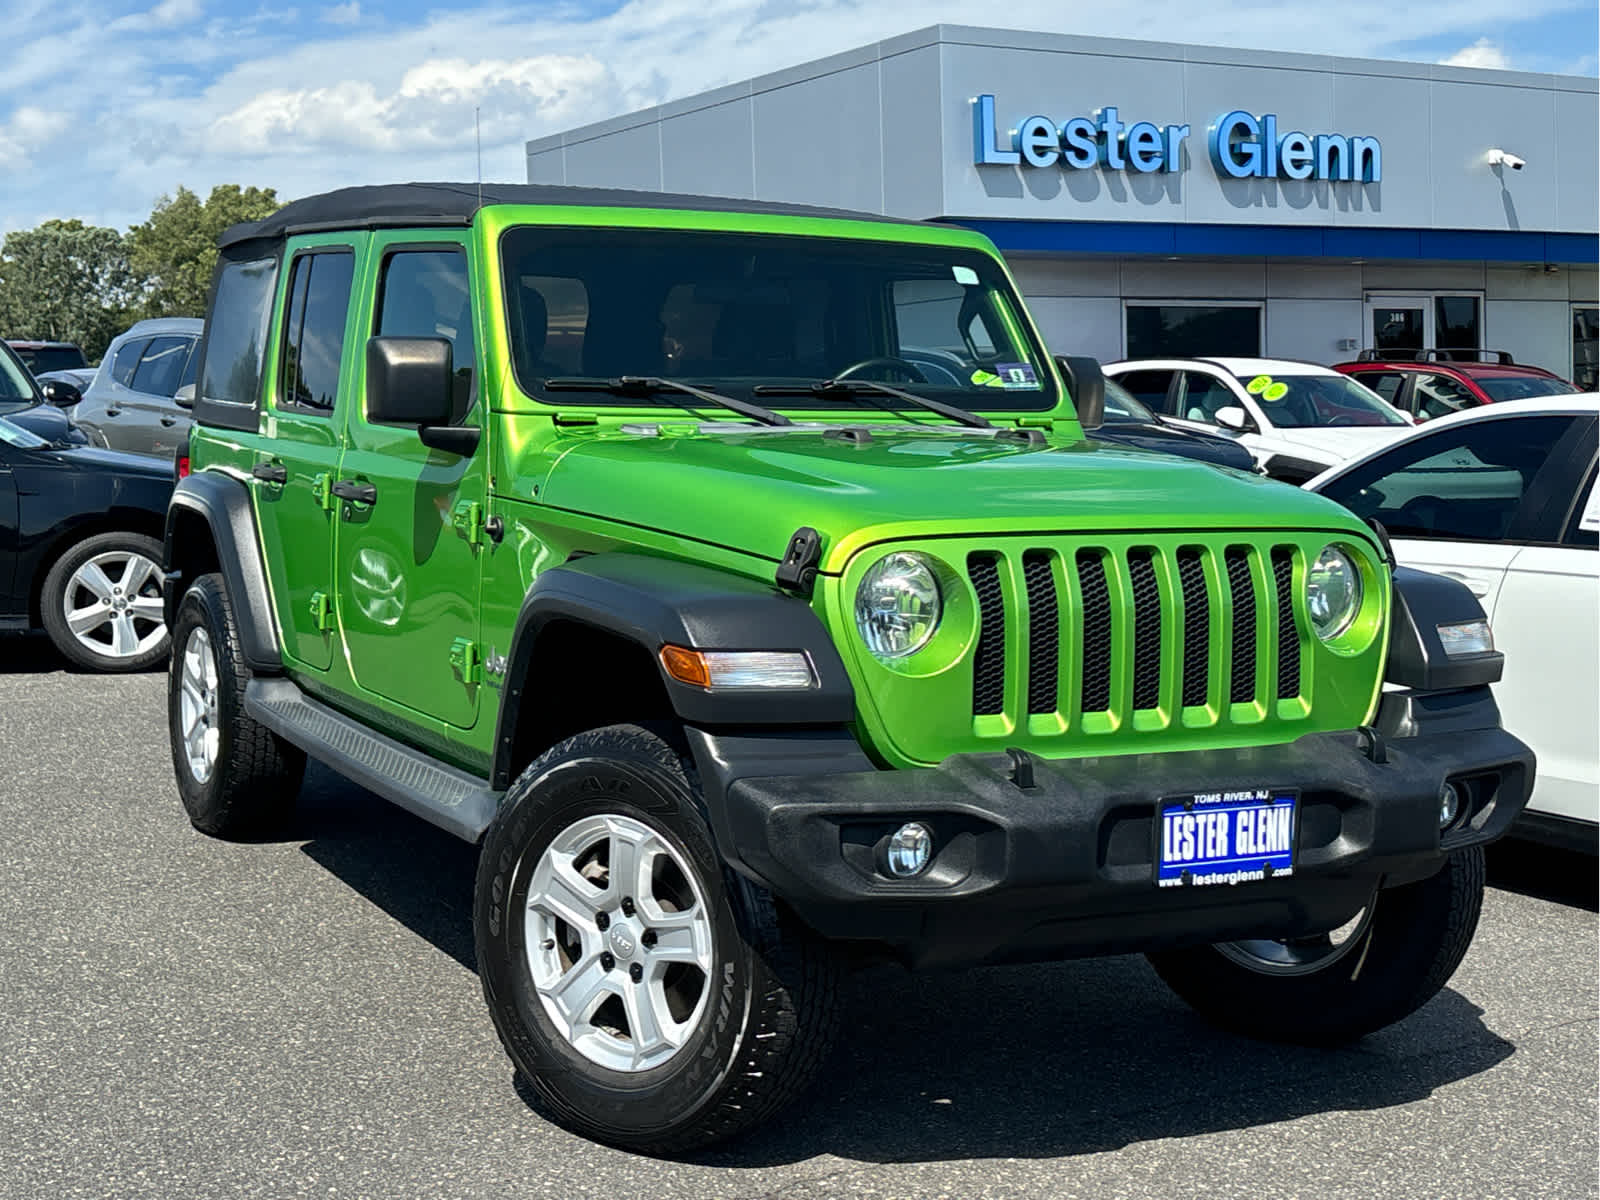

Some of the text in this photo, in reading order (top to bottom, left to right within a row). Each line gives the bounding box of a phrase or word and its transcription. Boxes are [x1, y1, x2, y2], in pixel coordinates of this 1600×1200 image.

[974, 94, 1381, 184] Lester Glenn
[1194, 790, 1269, 804] TOMS RIVER, NJ
[1163, 807, 1291, 862] LESTER GLENN
[1192, 869, 1264, 885] lesterglenn
